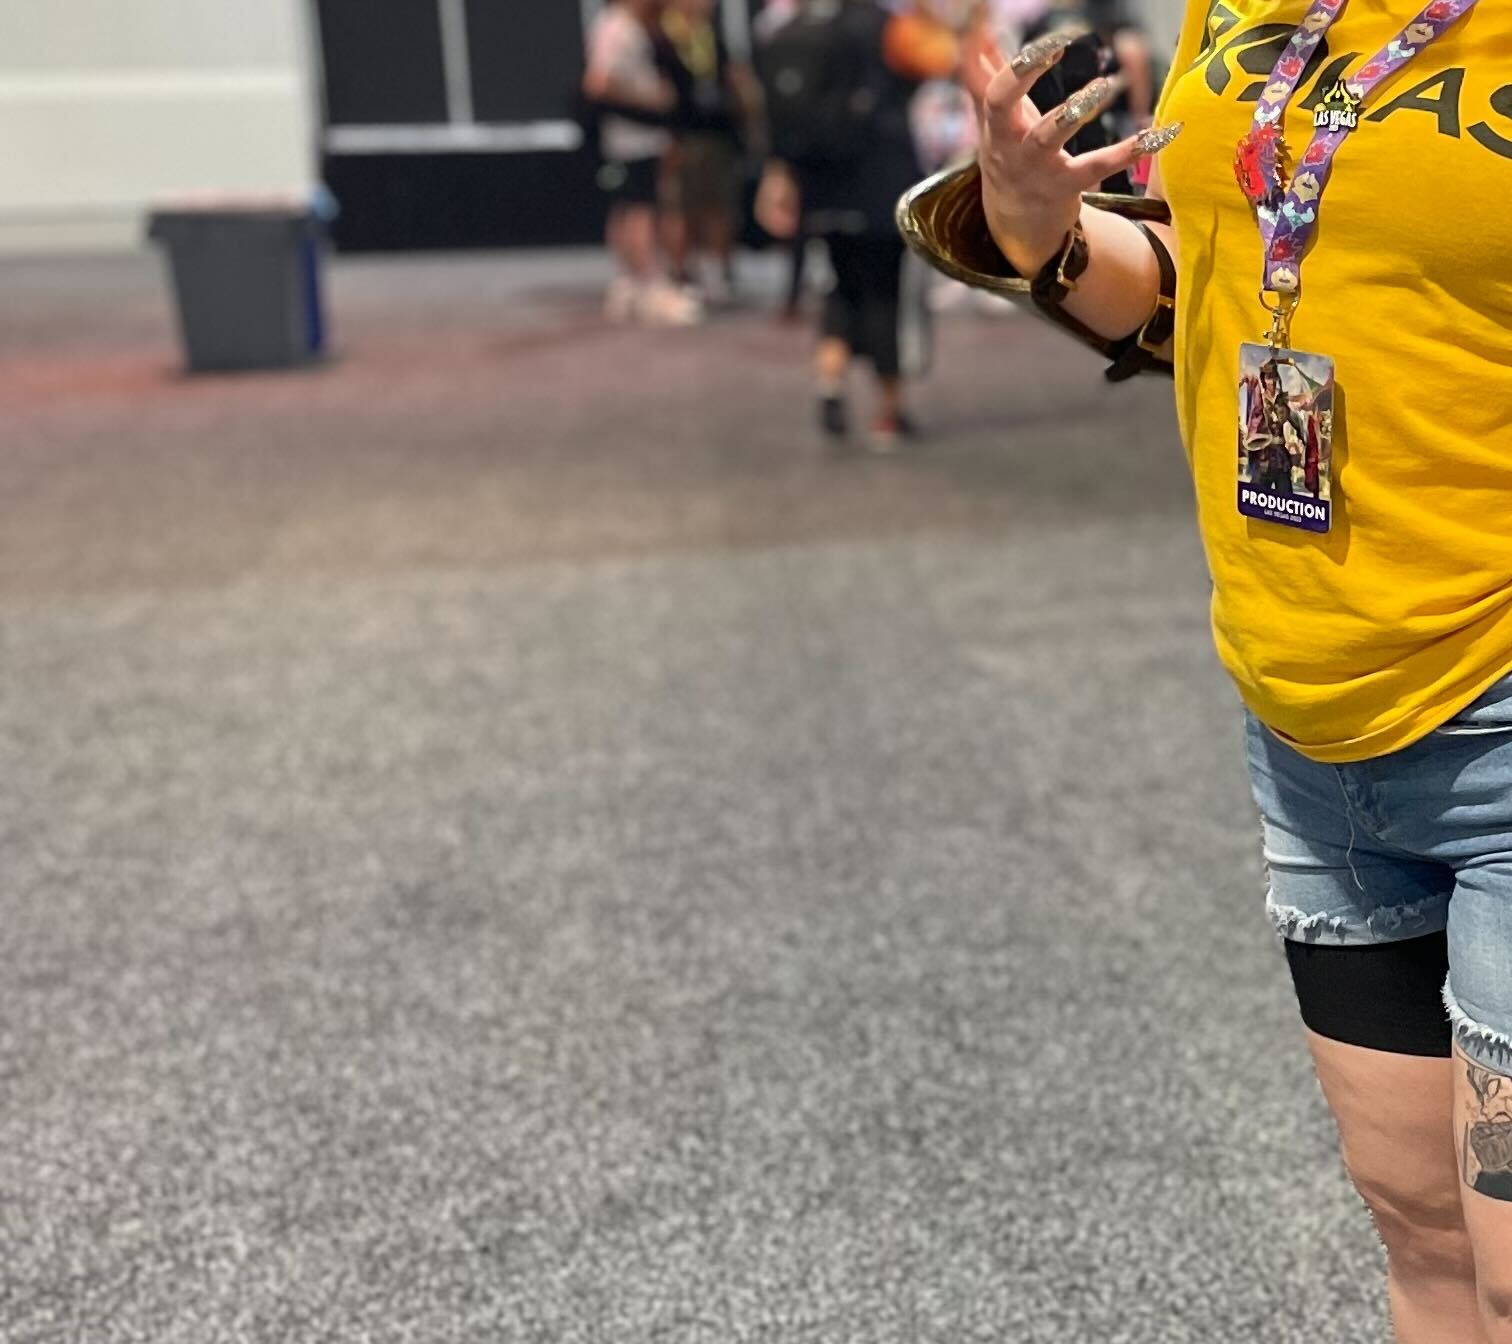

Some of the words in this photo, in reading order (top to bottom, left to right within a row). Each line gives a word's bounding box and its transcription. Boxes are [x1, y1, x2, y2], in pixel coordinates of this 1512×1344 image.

[1313, 109, 1329, 127] LAS
[1329, 109, 1358, 128] VEGAS
[1242, 490, 1325, 520] PRODUCTION
